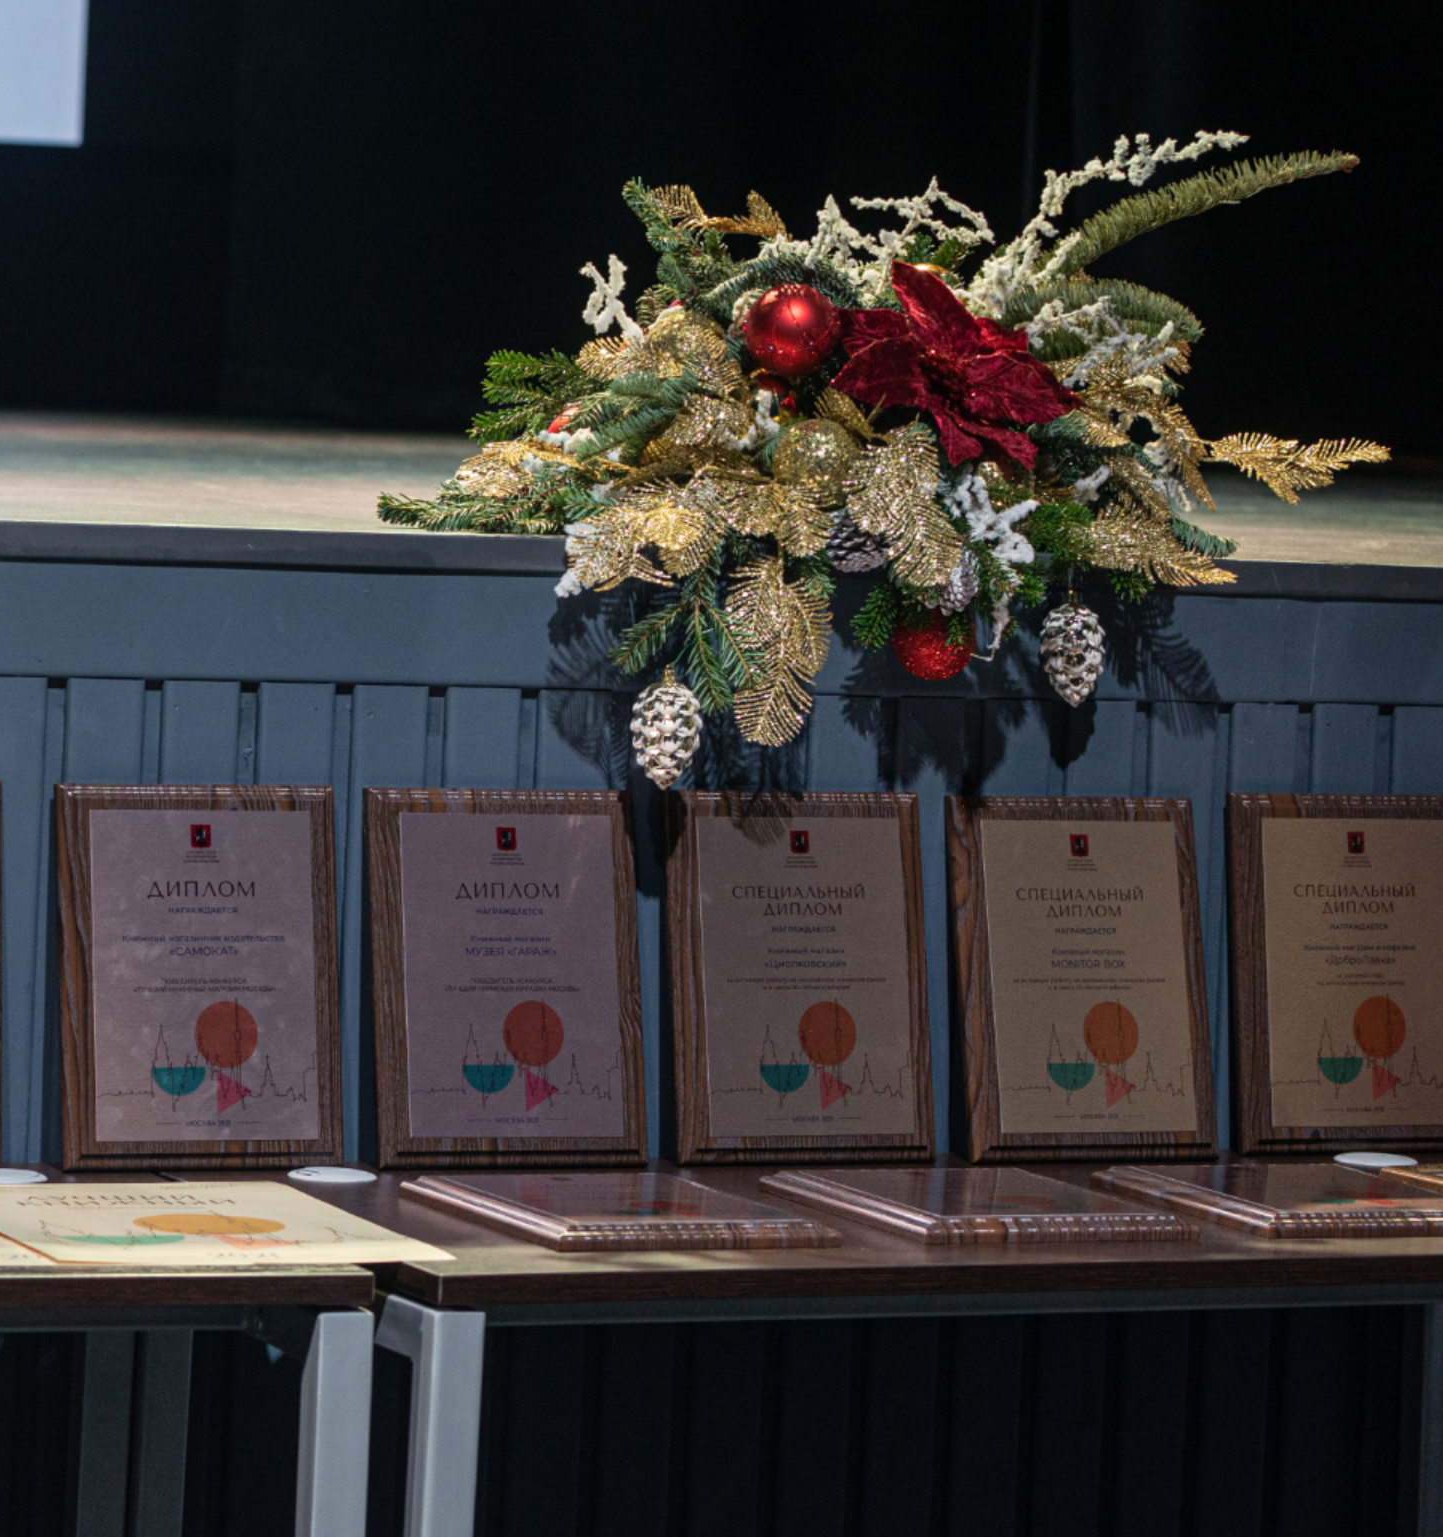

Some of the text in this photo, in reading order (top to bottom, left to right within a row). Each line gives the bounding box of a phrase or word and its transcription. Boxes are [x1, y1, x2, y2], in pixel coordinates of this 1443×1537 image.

[147, 881, 255, 899] ДИПЛОМ
[455, 882, 559, 900] ДИПЛОМ
[732, 883, 865, 900] СПЕЦИАЛЬНЫЙ
[1016, 886, 1144, 901] СПЕЦИАЛЬНЫЙ
[1293, 883, 1416, 898] СПЕЦИАЛЬНЫЙ
[168, 906, 238, 914] НАГРАЖДАЕТСЯ
[476, 908, 543, 916] НАГРАЖДАЕТСЯ
[763, 902, 842, 916] ДИПЛОМ
[1046, 904, 1122, 918] ДИПЛОМ
[1322, 901, 1394, 915] ДИПЛОМ
[1330, 923, 1389, 931] НАГРАЖДАЕТСЯ
[170, 946, 239, 956] «САМОКАТ»
[465, 947, 557, 956] МУЗЕЯ «ГАРАЖ»
[764, 959, 847, 969] «Циолковский»
[1051, 960, 1126, 969] MONITOR BOX
